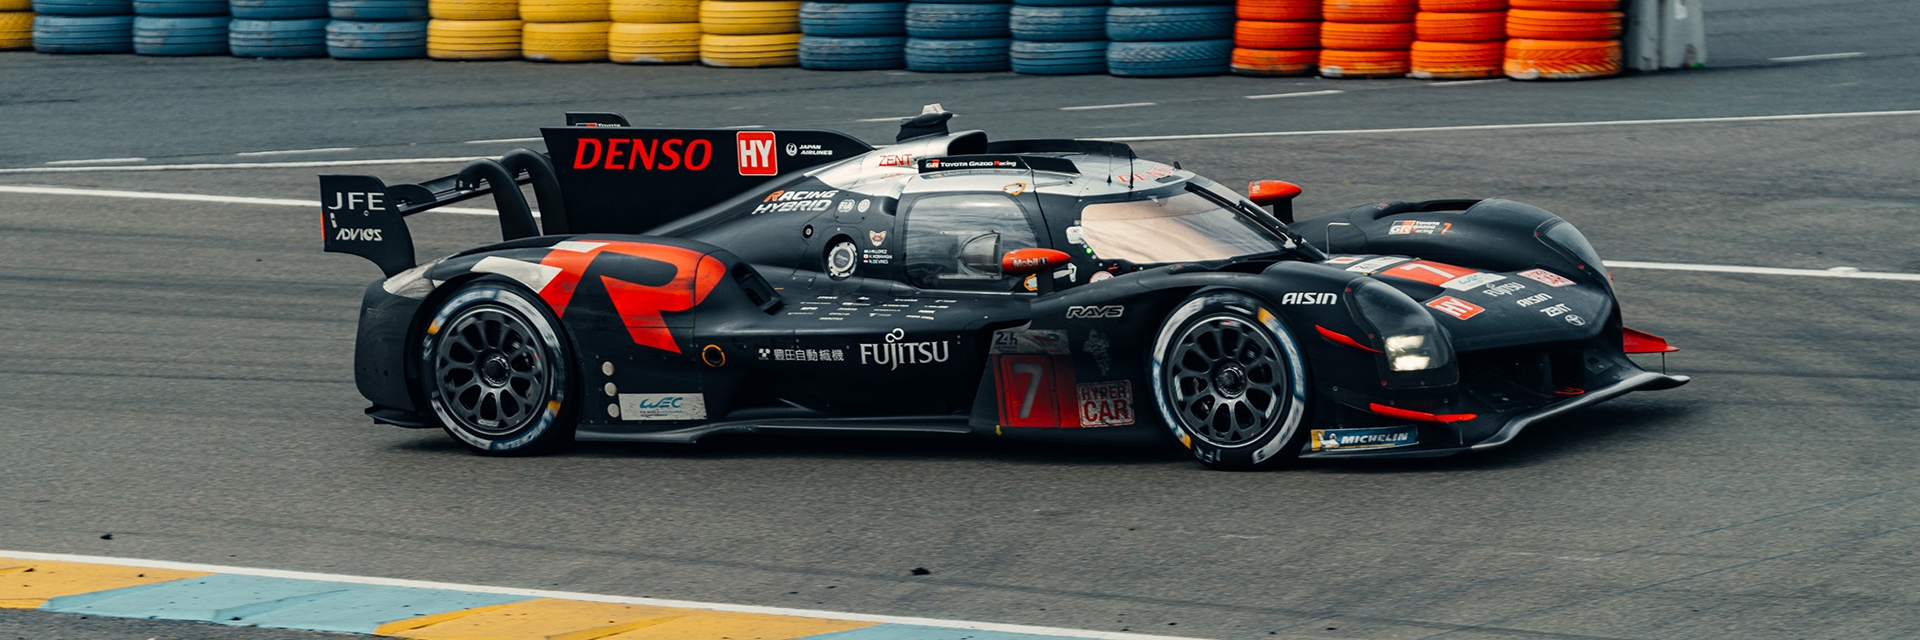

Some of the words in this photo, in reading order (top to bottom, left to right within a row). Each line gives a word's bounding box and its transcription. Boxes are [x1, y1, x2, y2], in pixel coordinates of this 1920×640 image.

[573, 137, 713, 171] DENSO
[740, 139, 773, 167] HY
[878, 153, 913, 167] ZENT
[994, 159, 1017, 168] Racing
[327, 191, 386, 211] JFE
[764, 189, 839, 202] RACING
[751, 199, 832, 215] HYBRID
[1440, 221, 1453, 235] 7
[1013, 258, 1039, 267] Mobil
[1282, 291, 1338, 305] AISIN
[1516, 292, 1554, 308] AISIN
[1066, 305, 1125, 319] RAYS
[1433, 297, 1475, 317] HY
[995, 330, 1018, 346] 24h
[859, 340, 950, 371] FUJITSU
[1011, 362, 1044, 419] 7
[1081, 386, 1127, 400] HYPER
[639, 396, 683, 409] WEC
[1084, 400, 1129, 422] CAR
[1341, 432, 1408, 444] MICHELIN
